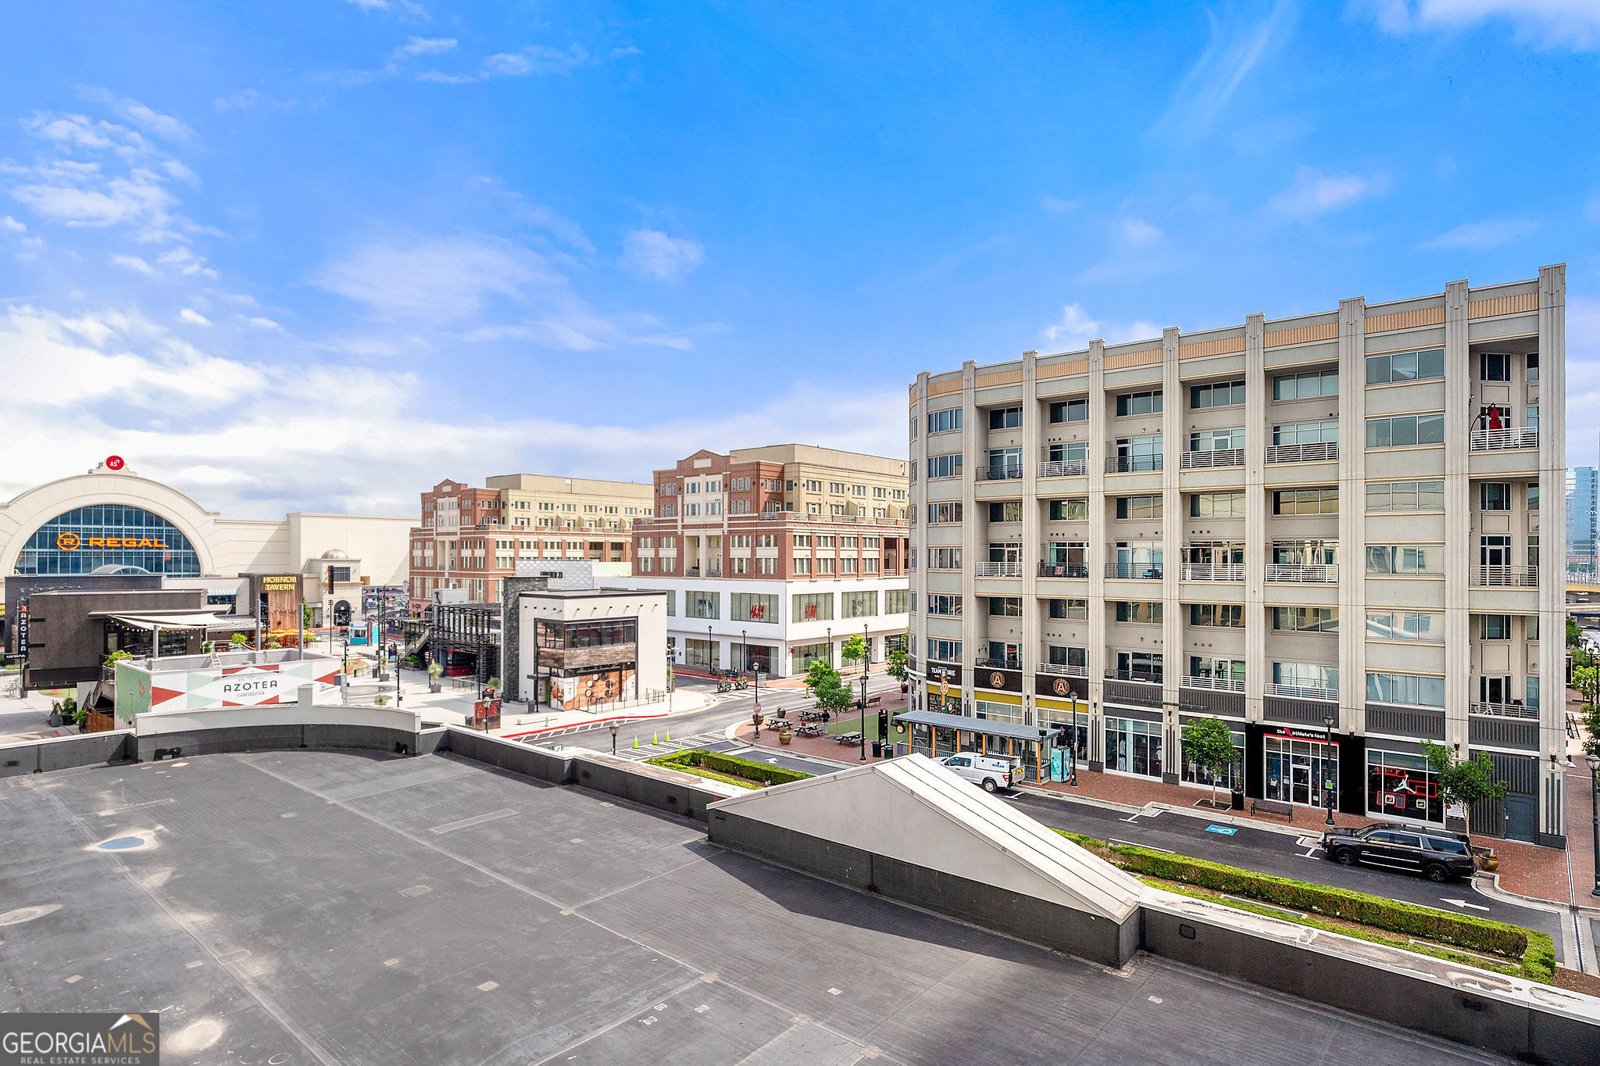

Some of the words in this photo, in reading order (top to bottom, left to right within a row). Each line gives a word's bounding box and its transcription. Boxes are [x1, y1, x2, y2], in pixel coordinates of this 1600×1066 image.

[89, 537, 167, 548] REGAL
[263, 576, 297, 584] HOBNOB
[265, 583, 295, 591] TAVERN
[993, 675, 1001, 685] A
[223, 680, 278, 693] AZOTEA
[1057, 682, 1065, 692] A
